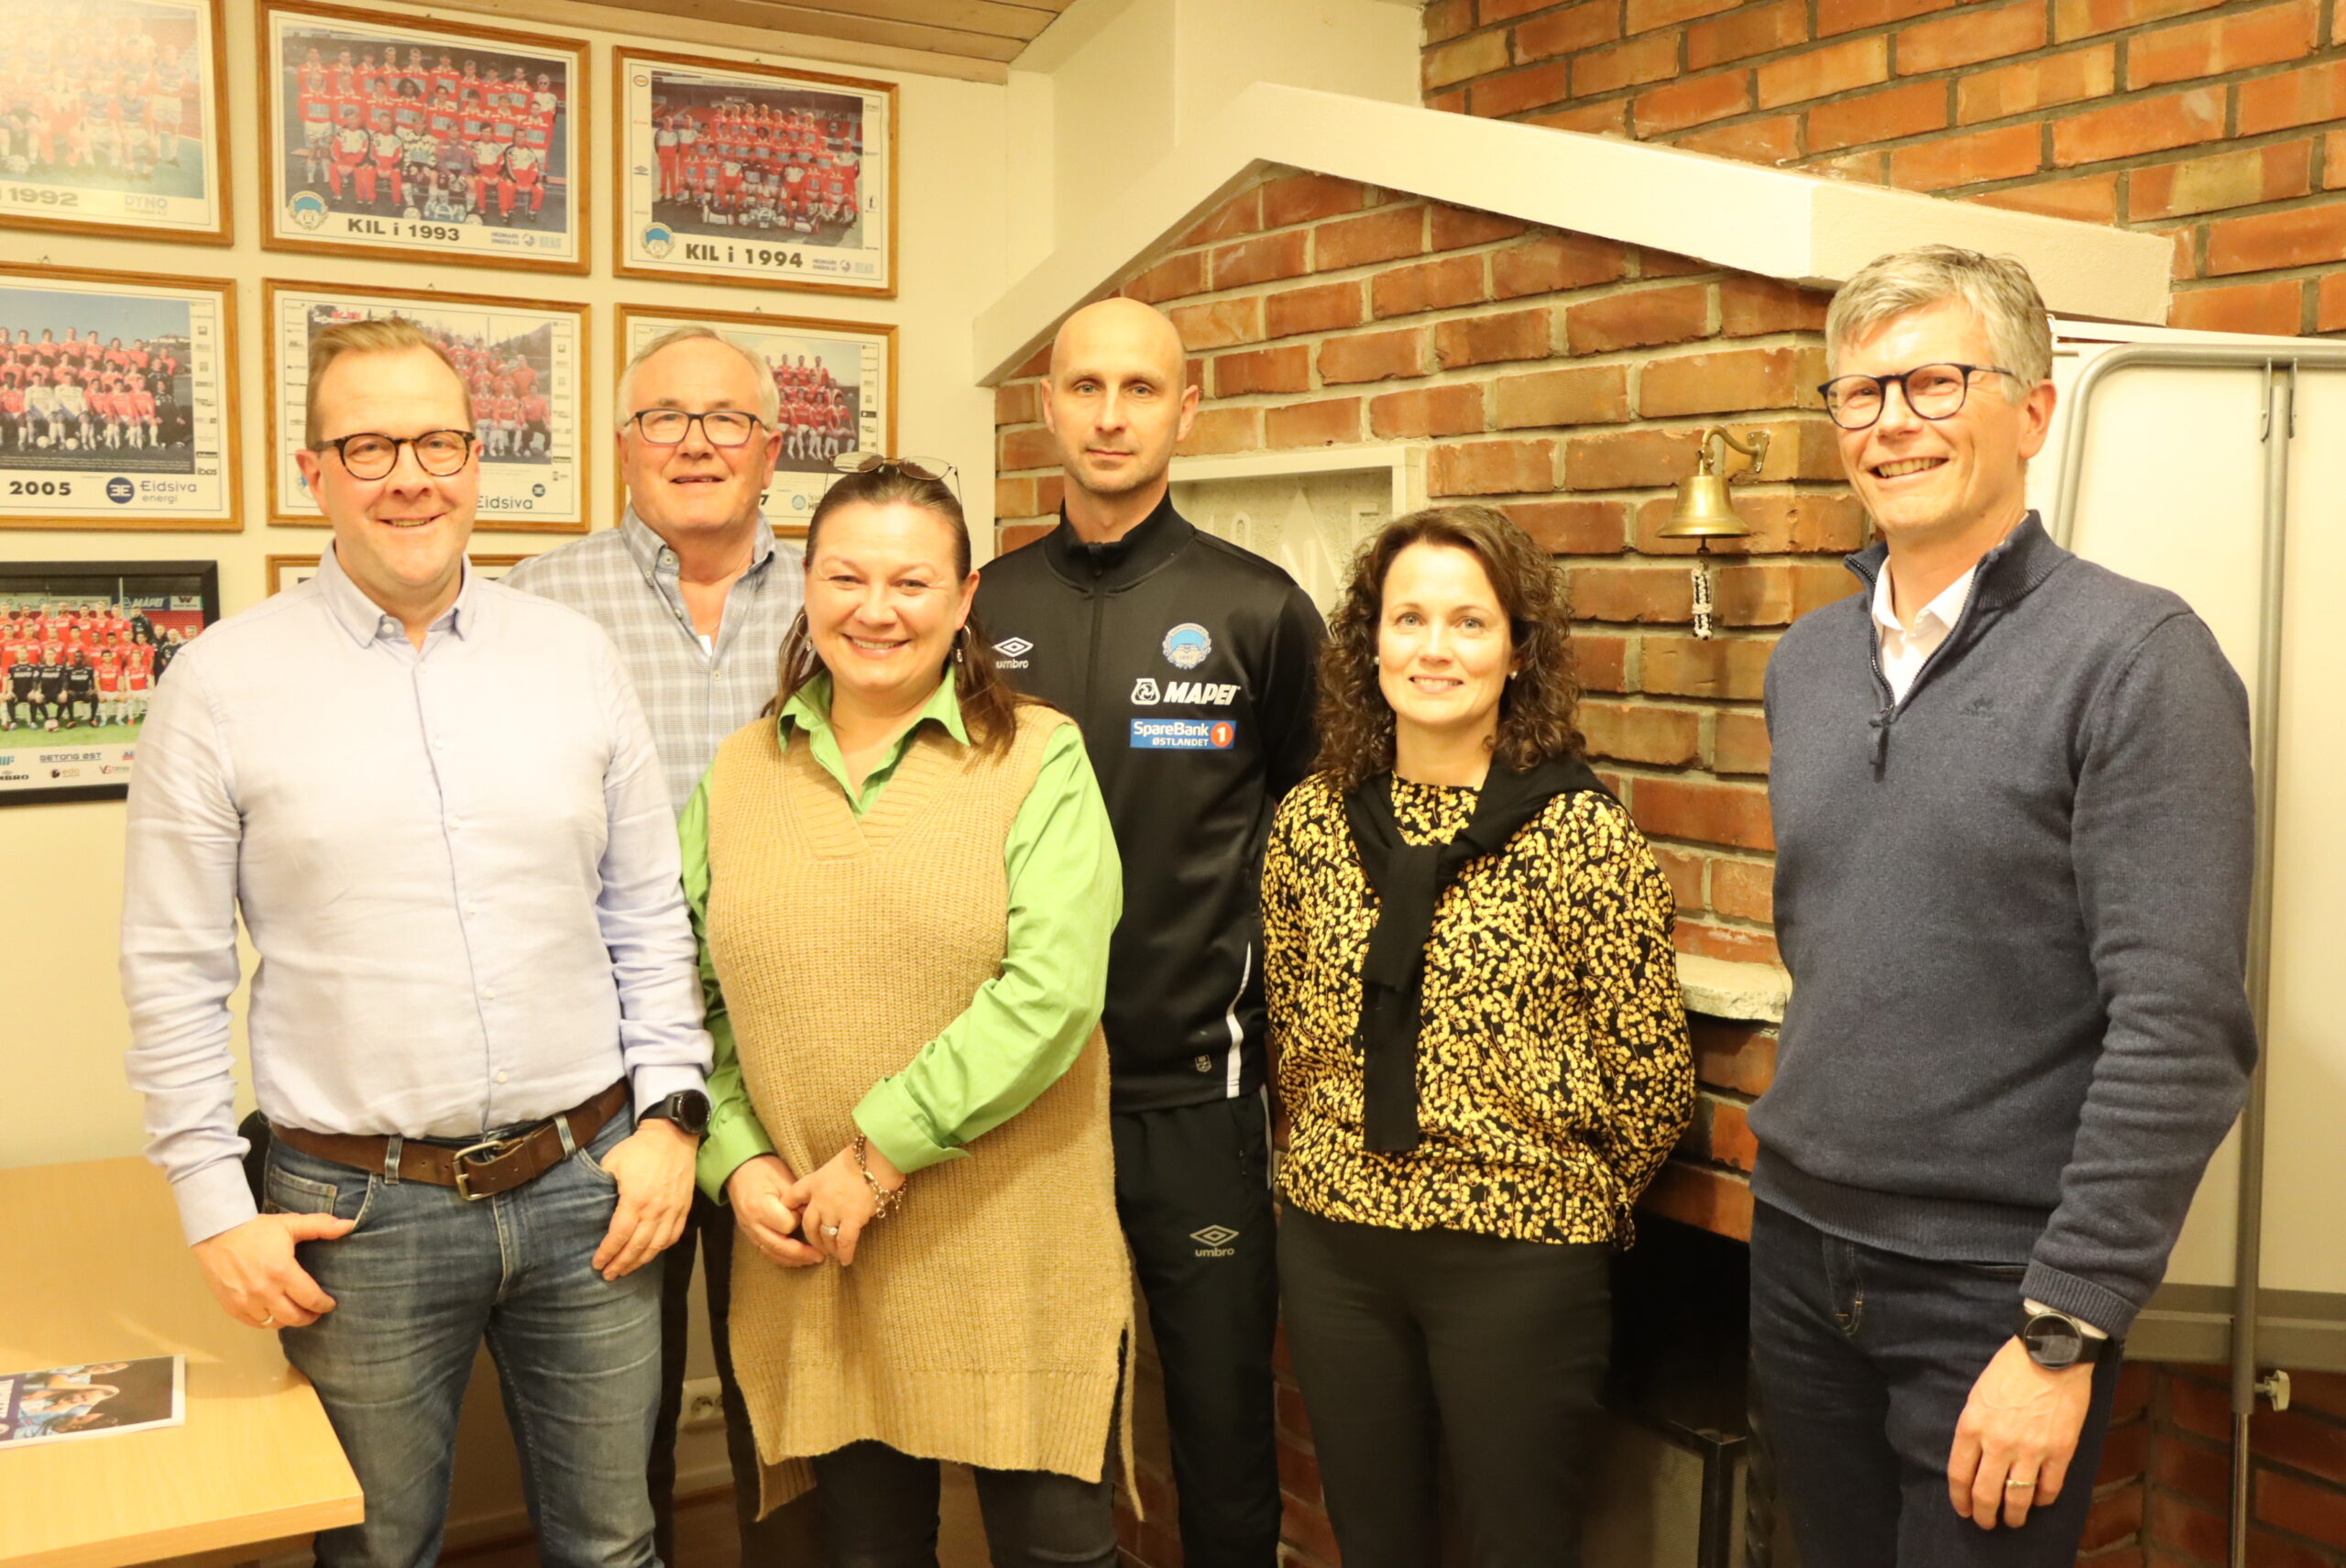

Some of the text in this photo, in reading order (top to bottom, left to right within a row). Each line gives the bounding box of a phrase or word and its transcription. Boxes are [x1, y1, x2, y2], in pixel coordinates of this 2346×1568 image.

[9, 187, 79, 207] 1992
[125, 194, 168, 210] DYNO
[347, 218, 461, 241] KIL i 1993
[685, 243, 803, 268] KIL i 1994
[9, 480, 71, 496] 2005
[140, 480, 197, 493] Eidsiva
[142, 495, 178, 504] energi
[477, 495, 533, 510] Eidsiva
[995, 659, 1029, 669] umbro
[1163, 681, 1239, 705] MAPEI
[1134, 720, 1227, 742] SpareBank 1
[1152, 737, 1209, 747] ØSTLANDET
[39, 753, 80, 762] BETONG
[1195, 1247, 1234, 1256] umbro
